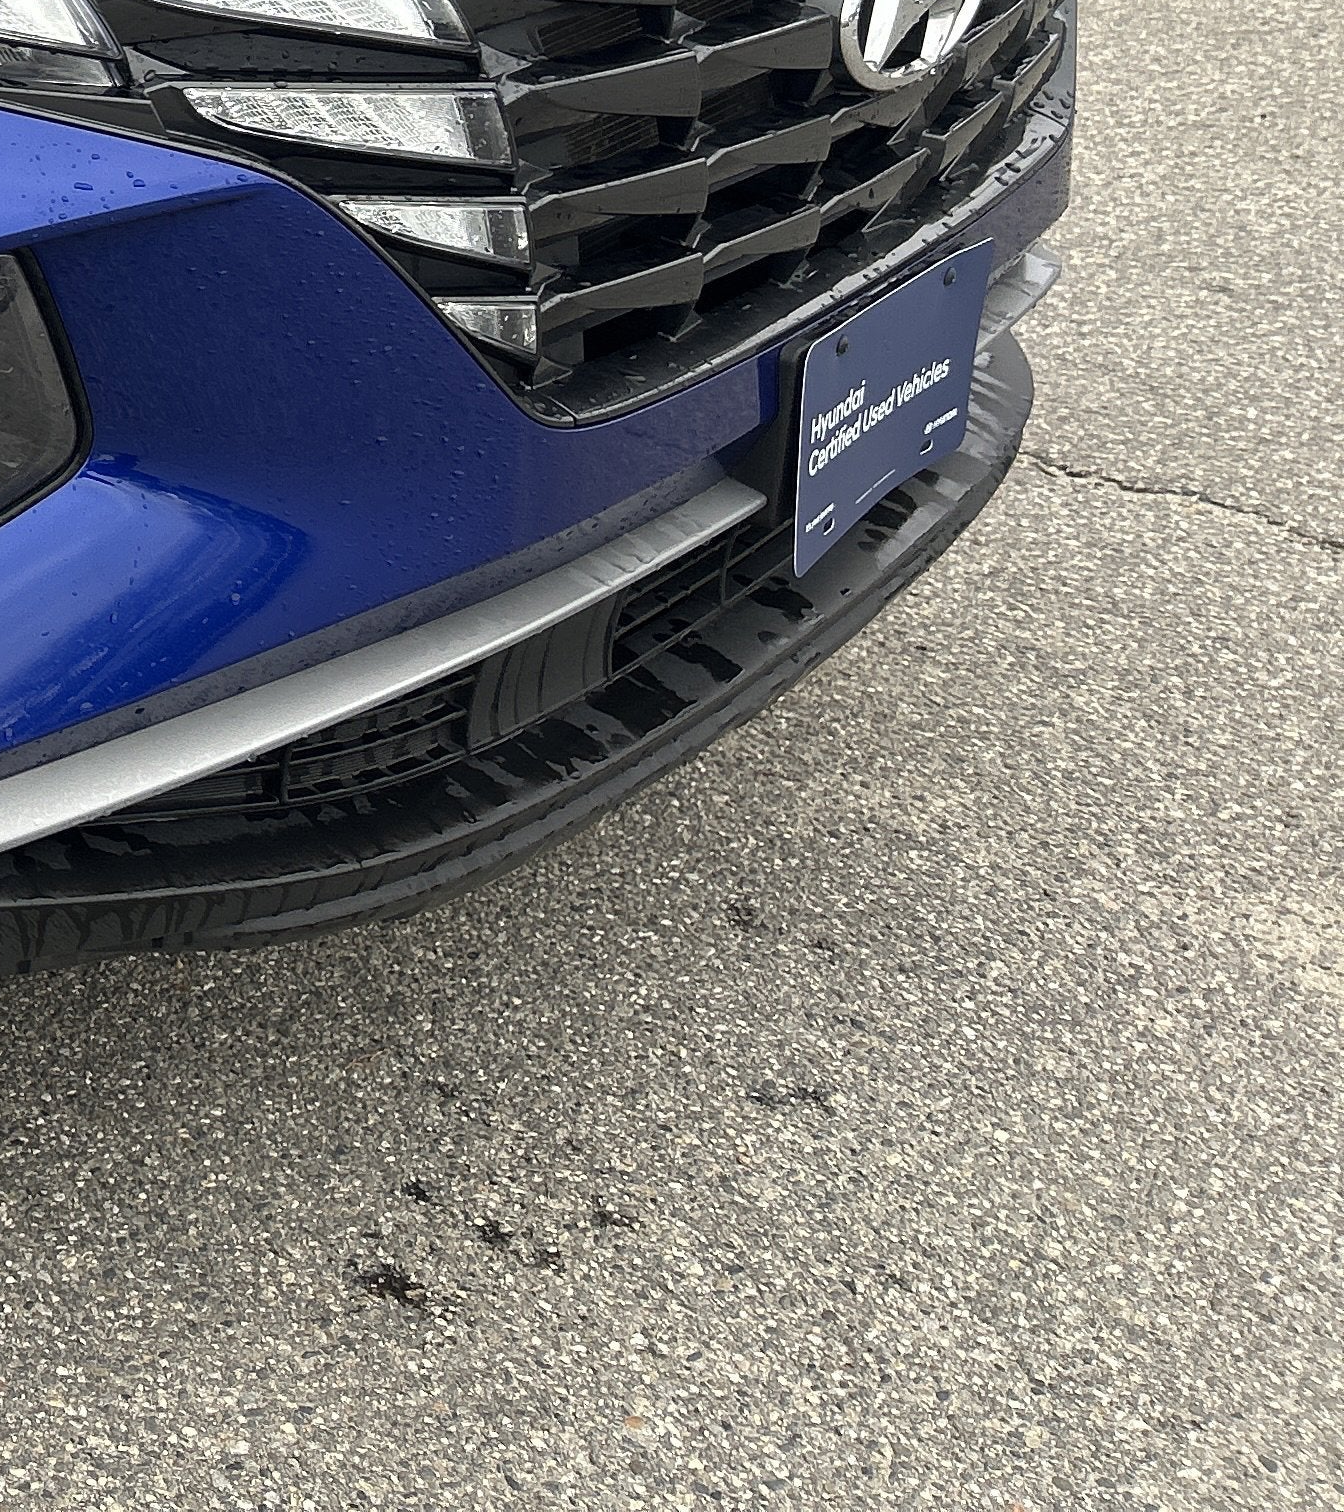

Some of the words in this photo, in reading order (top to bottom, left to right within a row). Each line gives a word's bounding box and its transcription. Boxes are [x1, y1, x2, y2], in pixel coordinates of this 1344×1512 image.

[808, 412, 862, 477] Certified
[862, 387, 896, 433] Used
[896, 358, 951, 407] Vehicles
[811, 379, 866, 444] Hyundai
